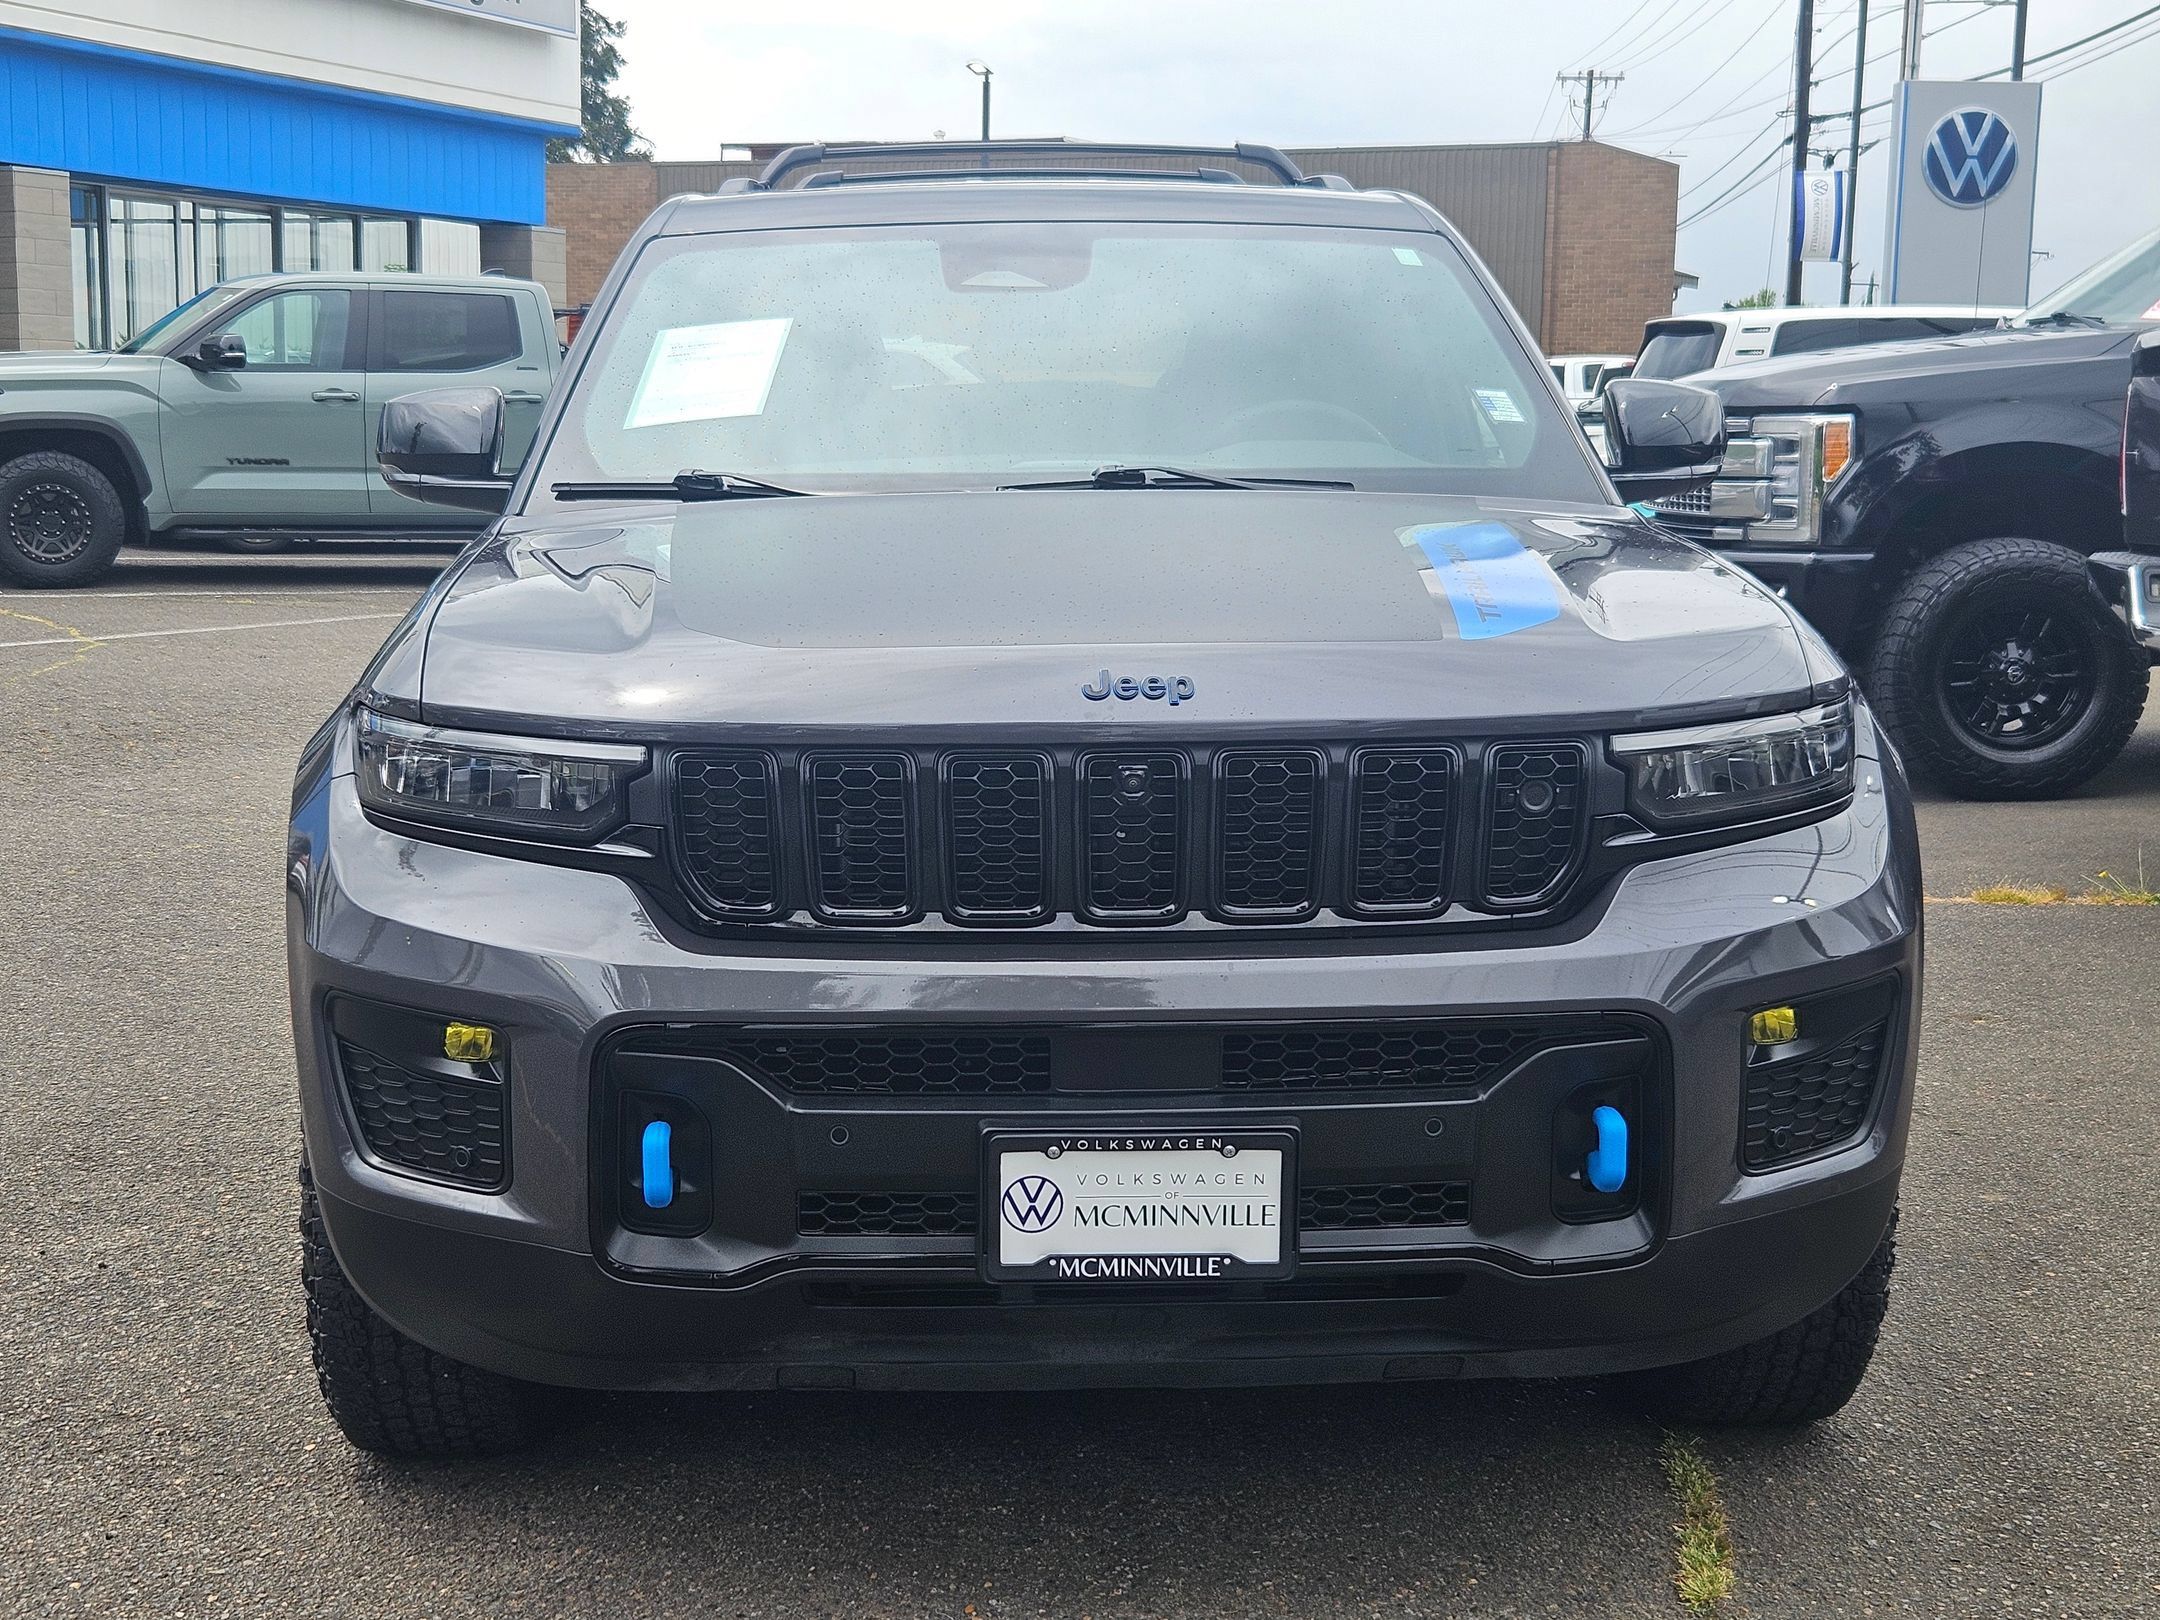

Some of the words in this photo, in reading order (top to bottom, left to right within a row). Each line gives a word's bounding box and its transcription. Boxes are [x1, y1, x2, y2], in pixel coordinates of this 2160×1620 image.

[1923, 107, 2018, 209] VW
[1081, 669, 1195, 706] Jeep
[1061, 1138, 1222, 1150] VOLKSWAGEN
[1076, 1173, 1266, 1186] VOLKSWAGEN
[1002, 1175, 1063, 1233] VW
[1164, 1191, 1180, 1200] OF
[1073, 1204, 1276, 1228] MCMINNVILLE
[1058, 1257, 1221, 1278] MCMINNVILLE
